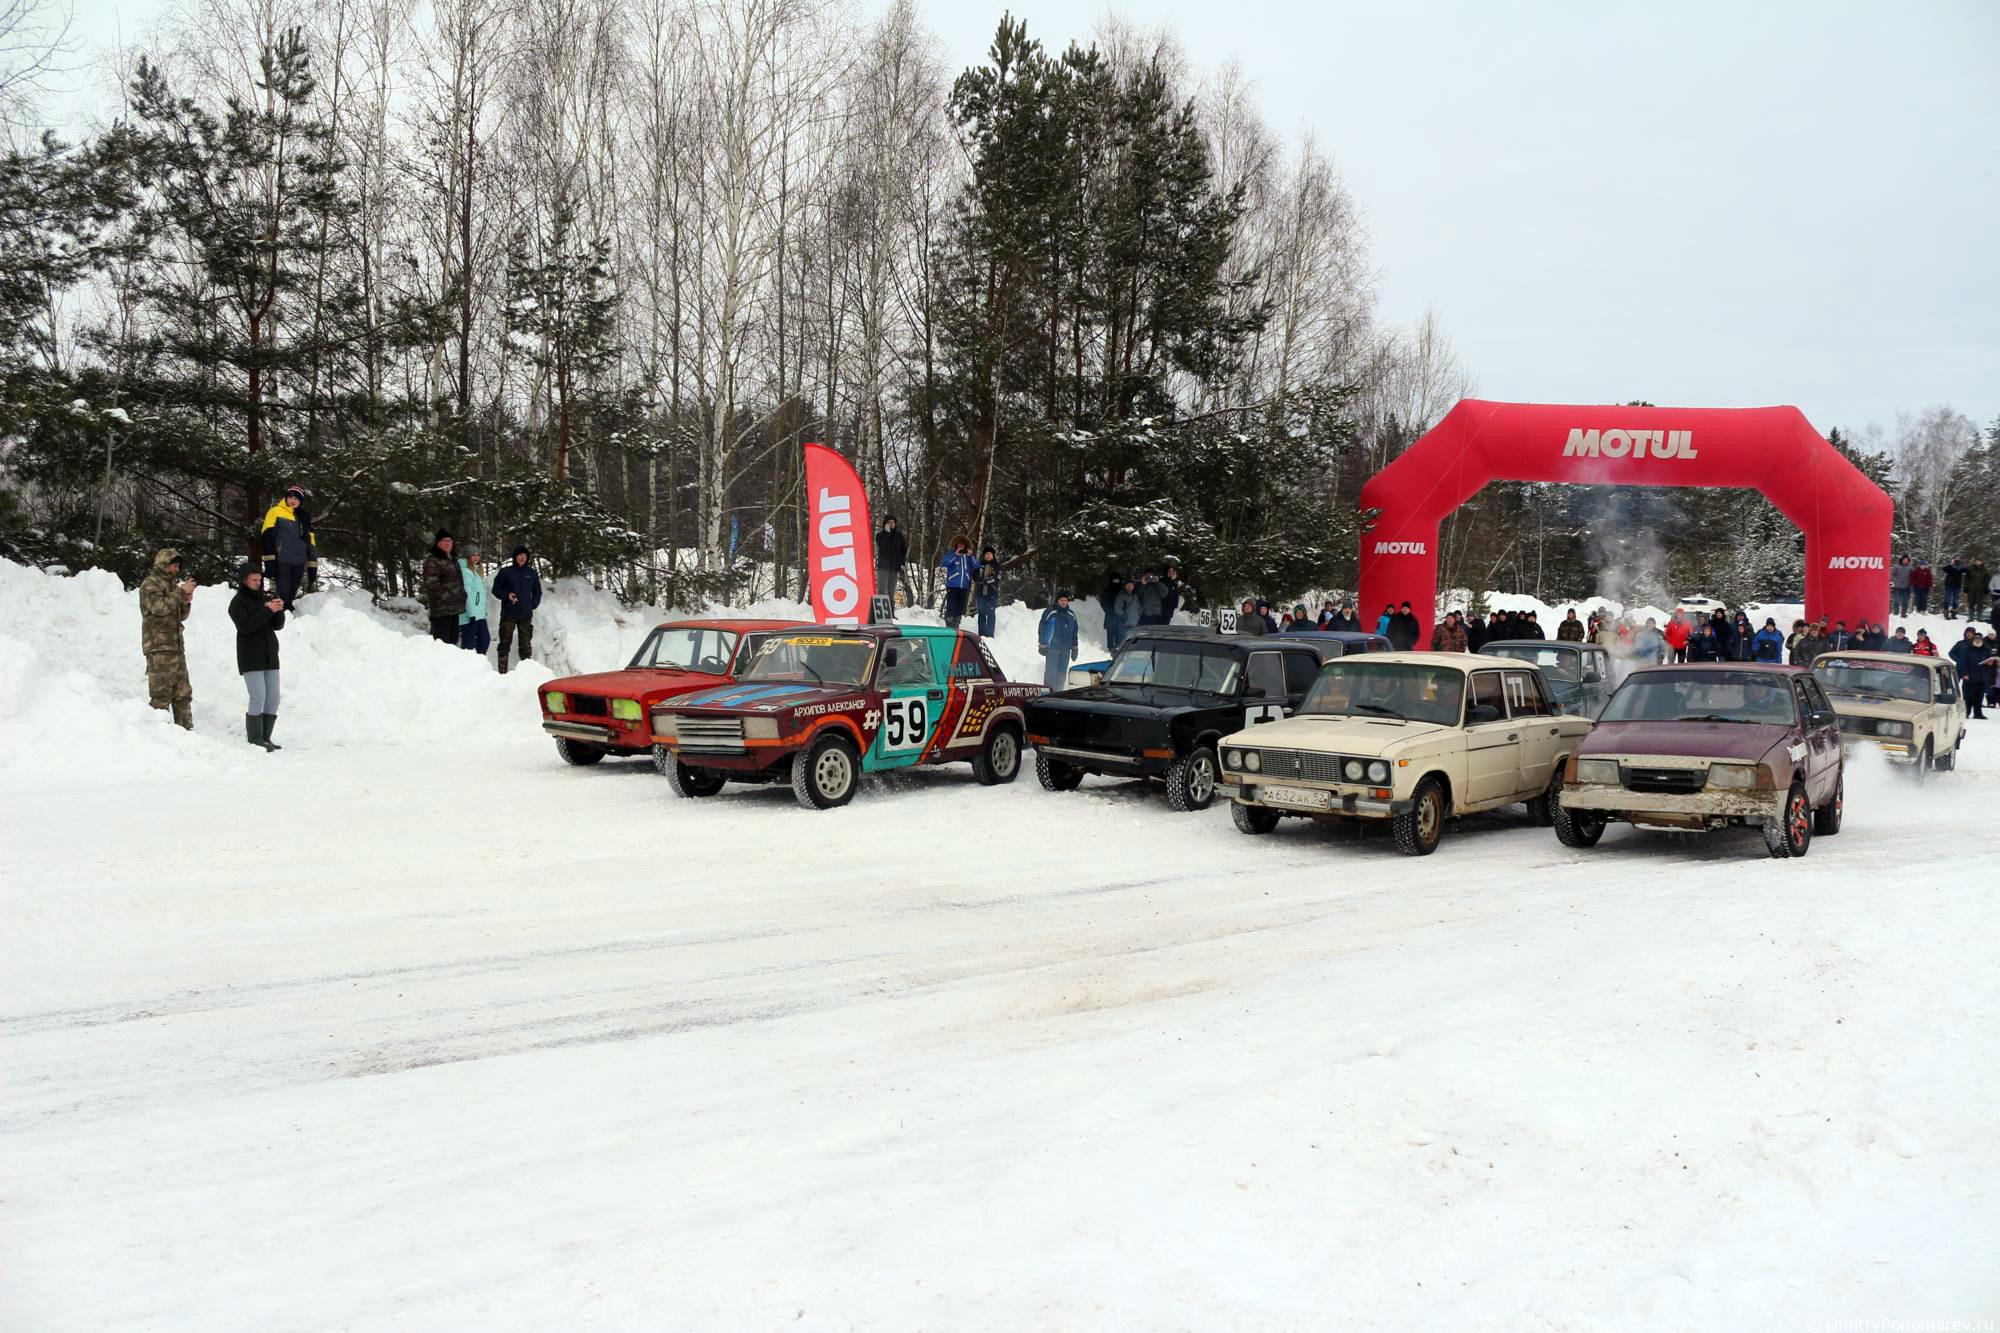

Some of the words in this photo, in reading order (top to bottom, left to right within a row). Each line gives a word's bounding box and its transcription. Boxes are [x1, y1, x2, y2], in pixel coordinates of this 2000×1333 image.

[1562, 428, 1698, 459] MOTUL
[1374, 541, 1427, 555] MOTUL
[1828, 556, 1885, 570] MOTUL
[874, 597, 892, 620] 59
[1200, 611, 1210, 626] 56
[1222, 613, 1236, 631] 52
[793, 704, 826, 718] АРХИПОВ
[827, 699, 866, 713] АЛЕКСАНДР
[885, 699, 927, 747] 59
